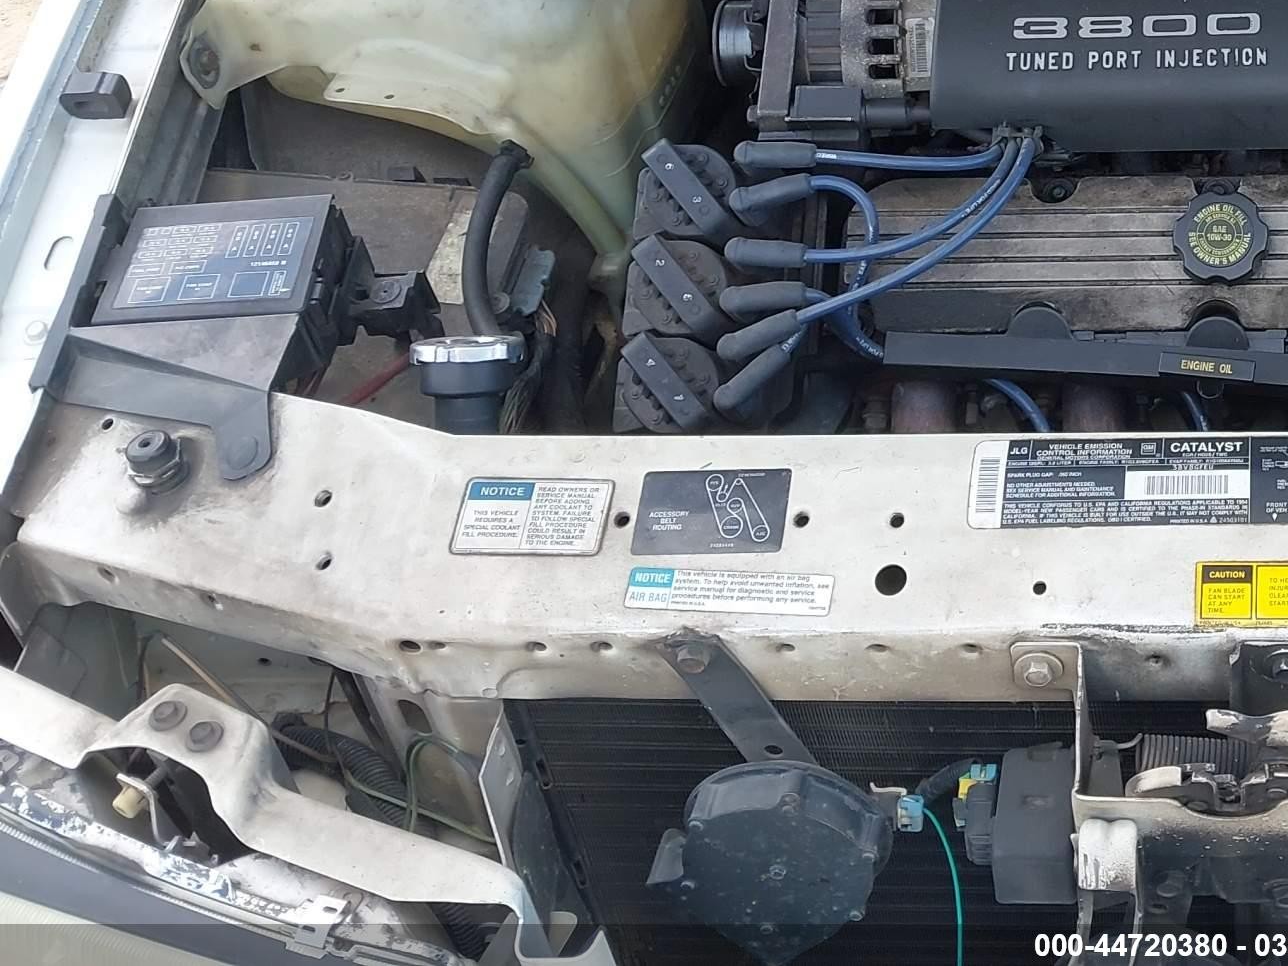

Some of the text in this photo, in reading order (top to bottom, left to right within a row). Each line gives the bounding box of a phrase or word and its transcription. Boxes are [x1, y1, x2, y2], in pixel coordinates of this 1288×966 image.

[1013, 12, 1261, 39] 3800
[1006, 47, 1268, 71] TUNED PORT INJECTION
[1193, 203, 1221, 223] ENGINE
[1222, 204, 1234, 214] OIL
[1234, 210, 1248, 226] FILL
[1206, 233, 1232, 241] 10W-30
[1188, 231, 1197, 248] SEE
[1228, 232, 1251, 263] MANUAL
[1180, 359, 1233, 374] ENGINE OIL
[1010, 447, 1028, 455] JLG
[1170, 442, 1243, 453] CATALYST
[480, 486, 526, 496] NOTICE
[634, 572, 672, 584] NOTICE
[727, 572, 758, 580] equipped
[1209, 570, 1246, 578] CAUTION
[630, 592, 667, 603] AIR BAG
[736, 596, 774, 604] performing
